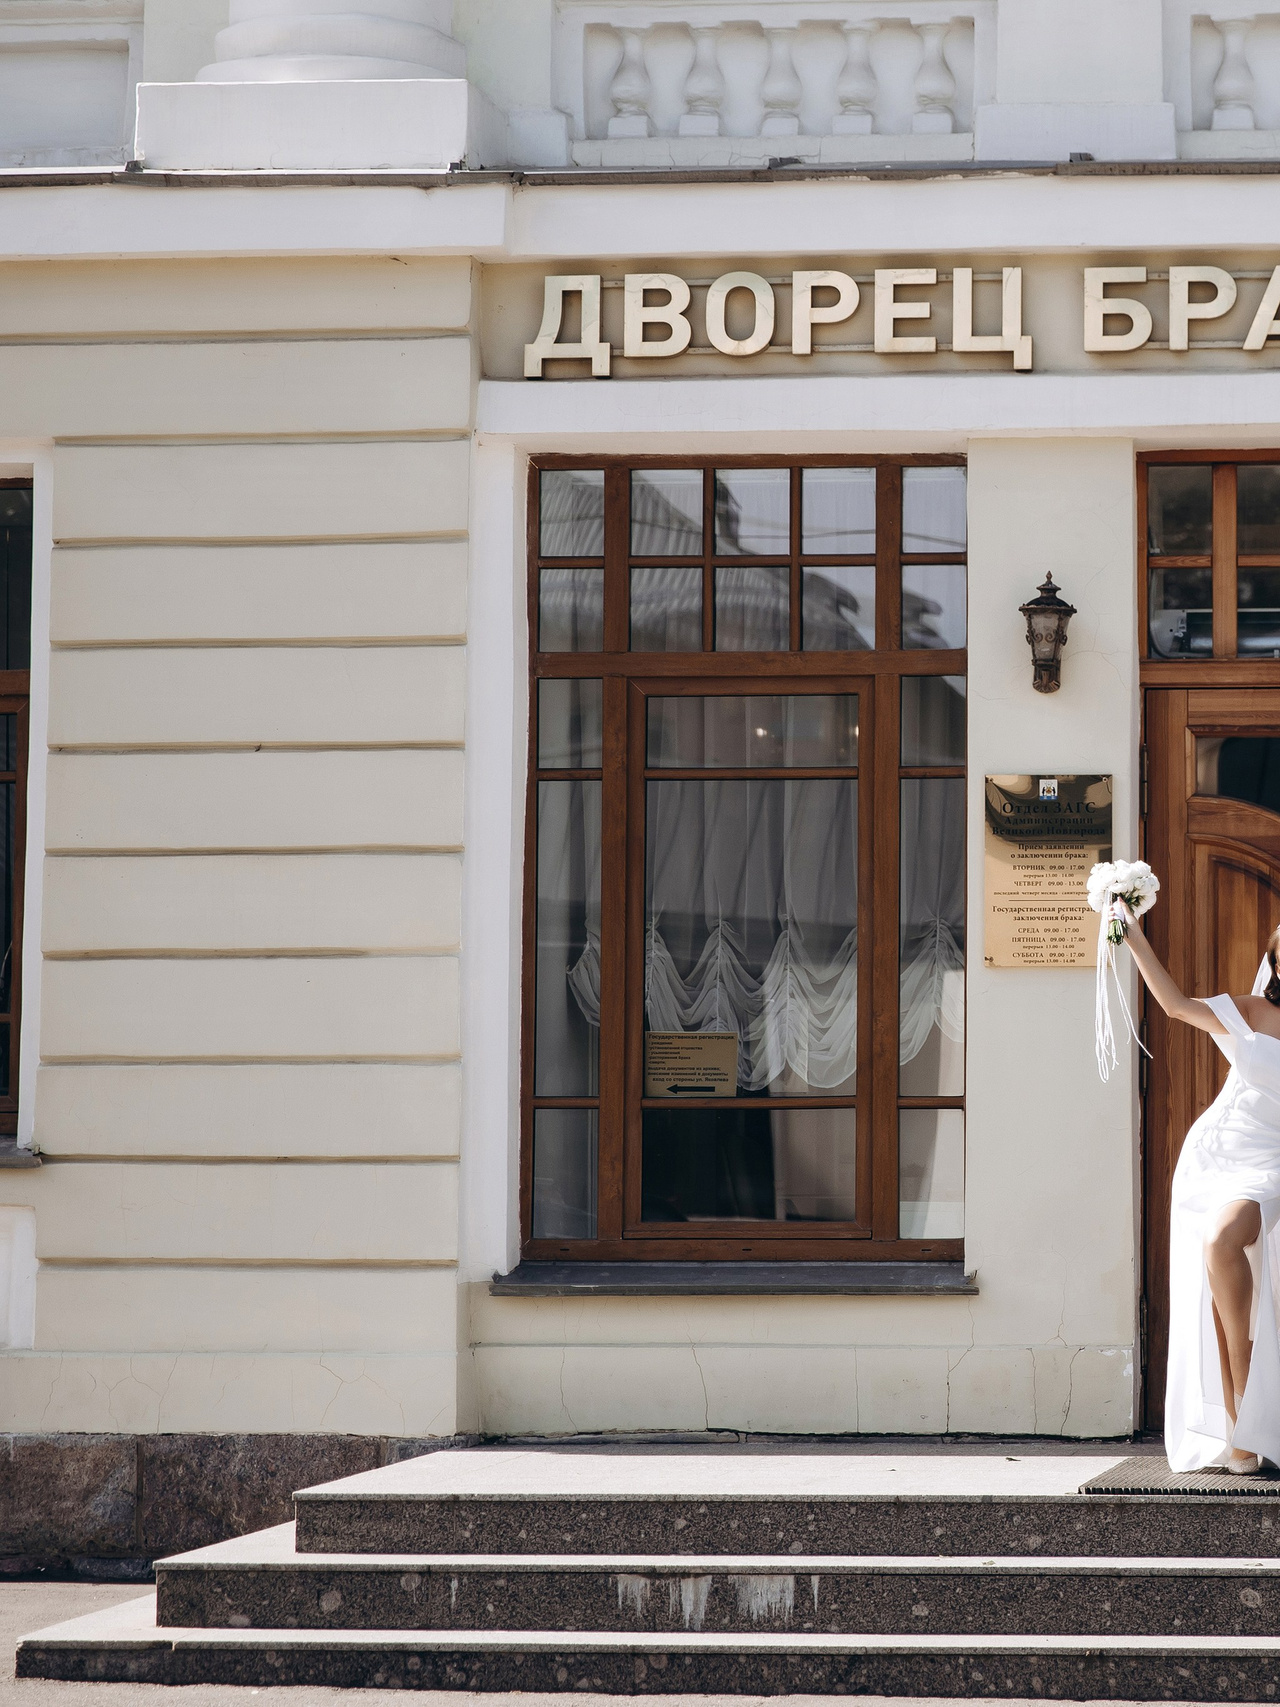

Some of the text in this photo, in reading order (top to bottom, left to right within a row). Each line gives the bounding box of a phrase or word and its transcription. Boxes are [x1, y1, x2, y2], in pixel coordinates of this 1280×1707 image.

[524, 266, 1033, 379] ДВОРЕЦ
[1003, 802, 1096, 814] Отдел ЗАГС
[1004, 817, 1093, 825] Администрации
[992, 827, 1105, 837] Великого Новгорода
[1065, 852, 1088, 860] брака:
[1060, 914, 1084, 922] брака:
